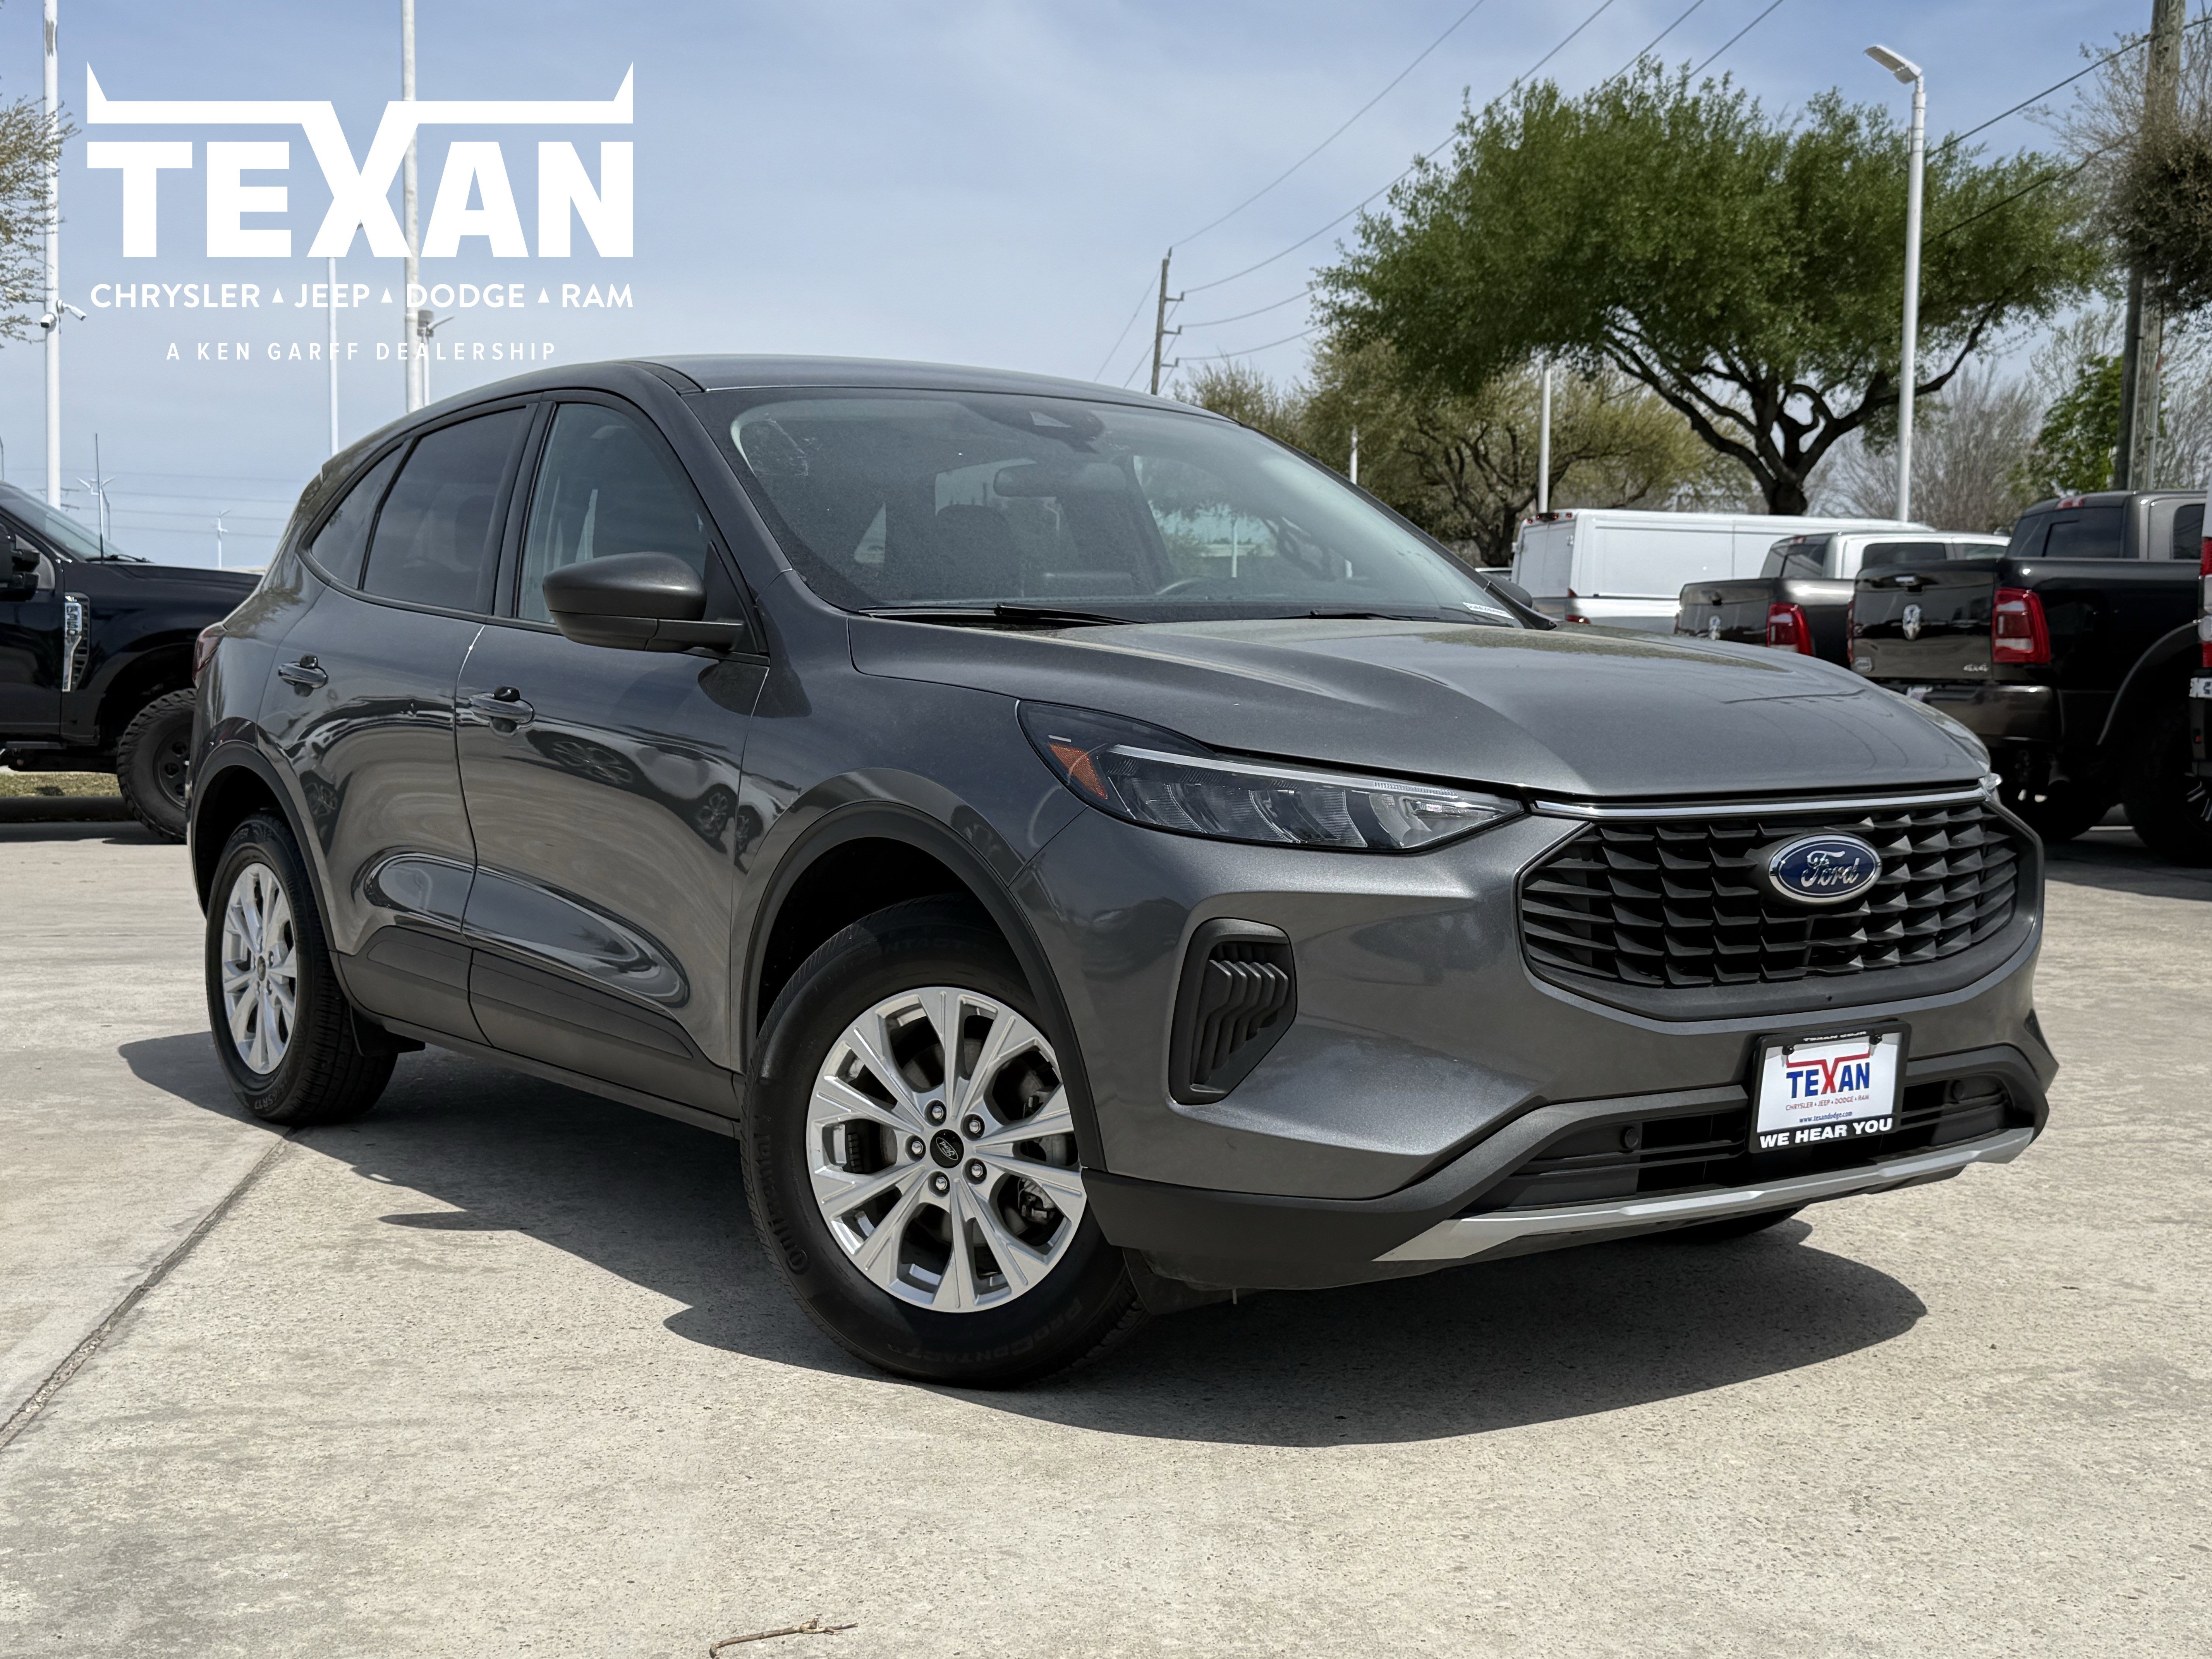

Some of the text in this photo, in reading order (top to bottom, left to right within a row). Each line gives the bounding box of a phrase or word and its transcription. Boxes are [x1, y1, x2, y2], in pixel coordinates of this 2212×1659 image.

[1801, 850, 1860, 887] Ford
[1786, 1054, 1870, 1098] TEXAN
[1786, 1102, 1813, 1111] CHRYSLER
[1760, 1118, 1893, 1148] WE HEAR YOU
